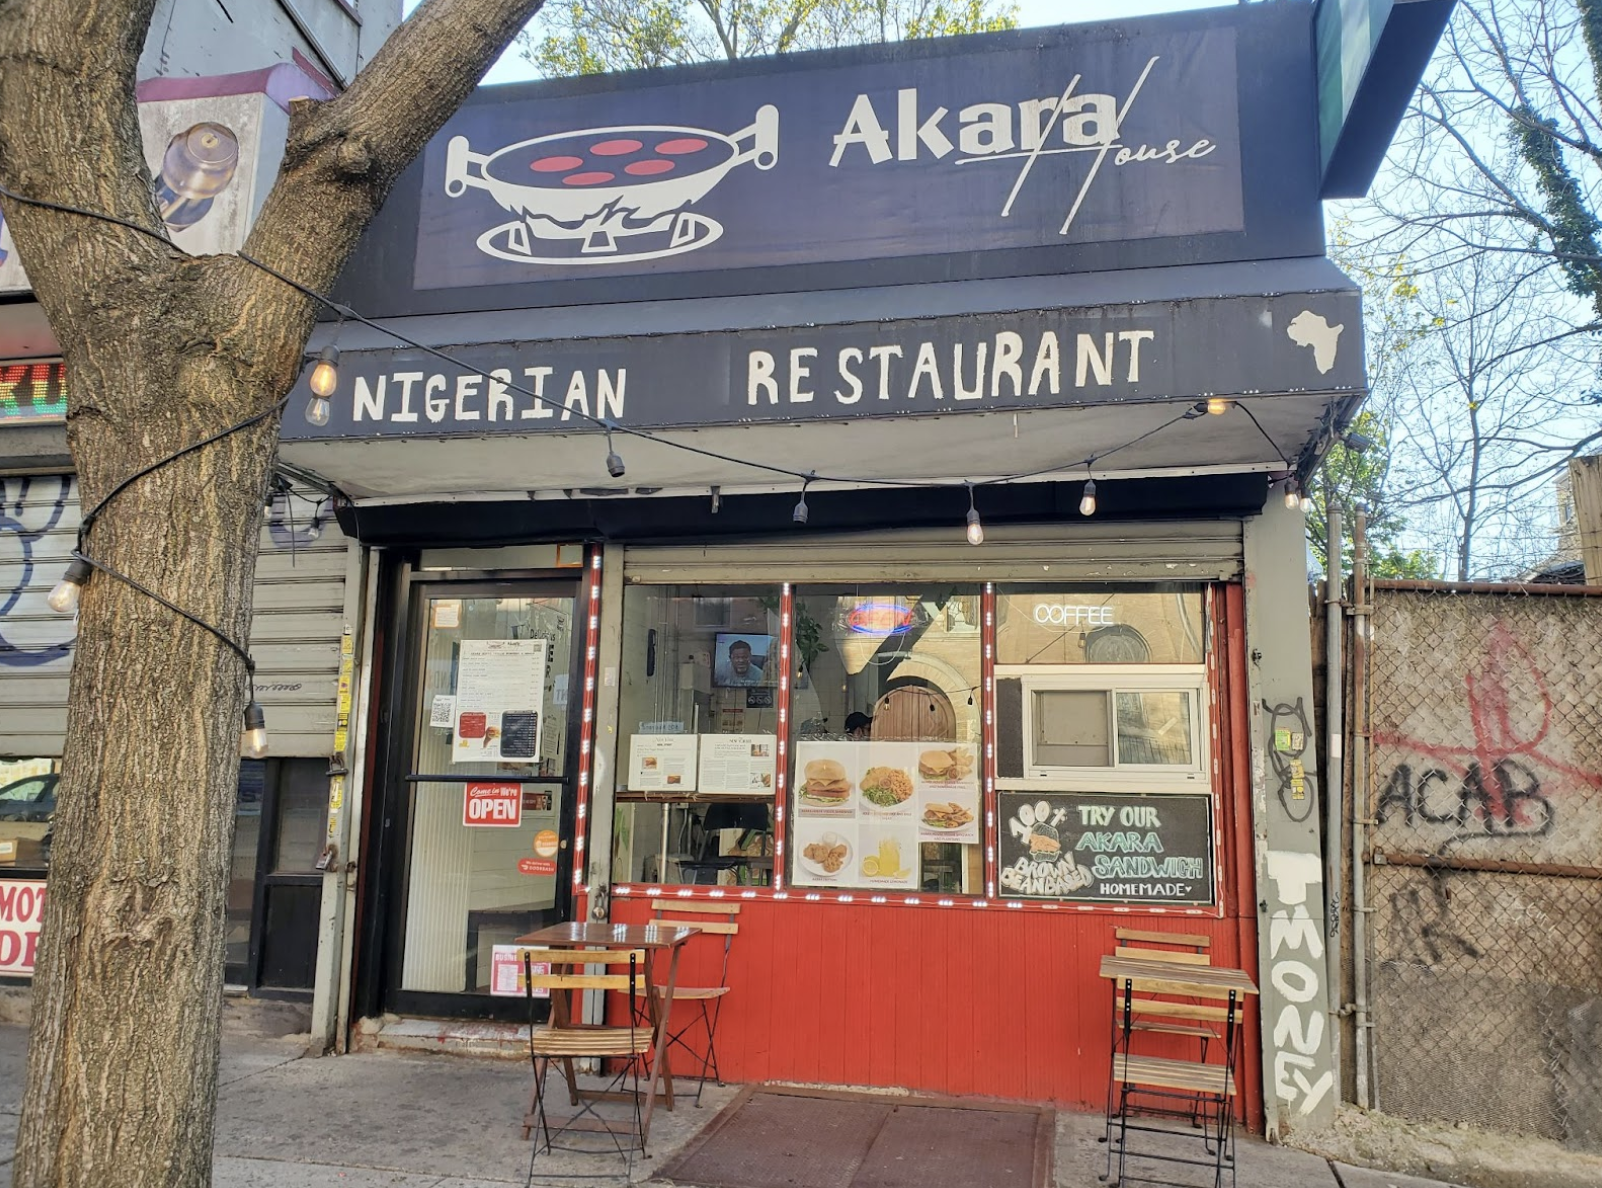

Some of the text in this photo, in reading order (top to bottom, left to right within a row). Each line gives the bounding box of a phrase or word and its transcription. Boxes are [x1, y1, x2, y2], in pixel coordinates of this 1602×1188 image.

[828, 87, 1121, 167] Akara
[352, 330, 1155, 423] NIGERIAN RESTAURANT
[1034, 604, 1114, 626] COFFEE
[470, 786, 491, 797] Come
[491, 786, 500, 794] in
[1374, 757, 1555, 837] ACAB
[468, 798, 517, 819] OPEN
[1078, 805, 1162, 828] TRY OUR
[1075, 831, 1164, 853] AKARA
[1014, 851, 1077, 879] BROWN
[1092, 855, 1204, 879] SANDWICH
[1100, 883, 1185, 896] HOMEMADE
